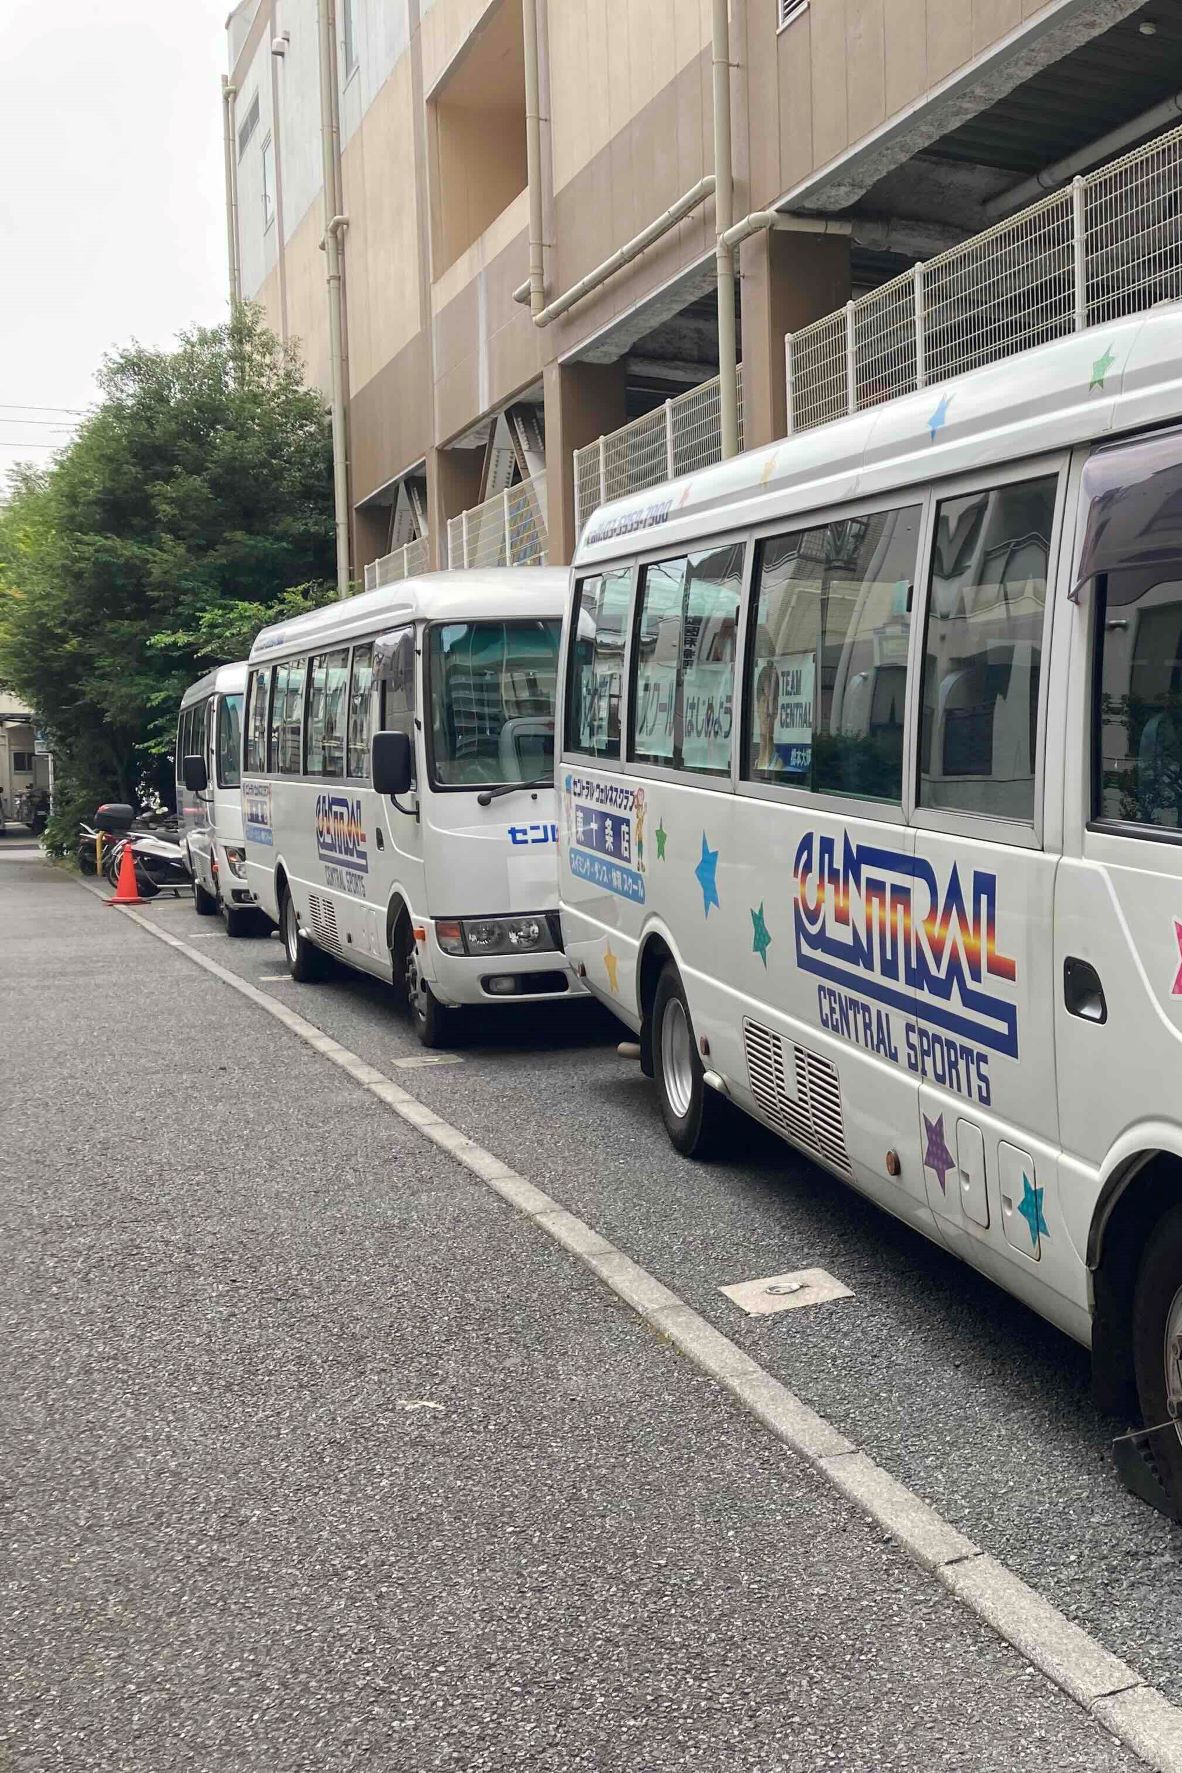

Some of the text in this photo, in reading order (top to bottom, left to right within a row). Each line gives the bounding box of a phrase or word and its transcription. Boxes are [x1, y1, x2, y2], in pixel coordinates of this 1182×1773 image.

[781, 669, 802, 696] TEAM
[780, 701, 812, 729] CENTRAL
[576, 808, 631, 860] 東十条店
[793, 827, 1019, 1059] CENTRAL
[817, 984, 992, 1107] CENTRAL SPORTS
